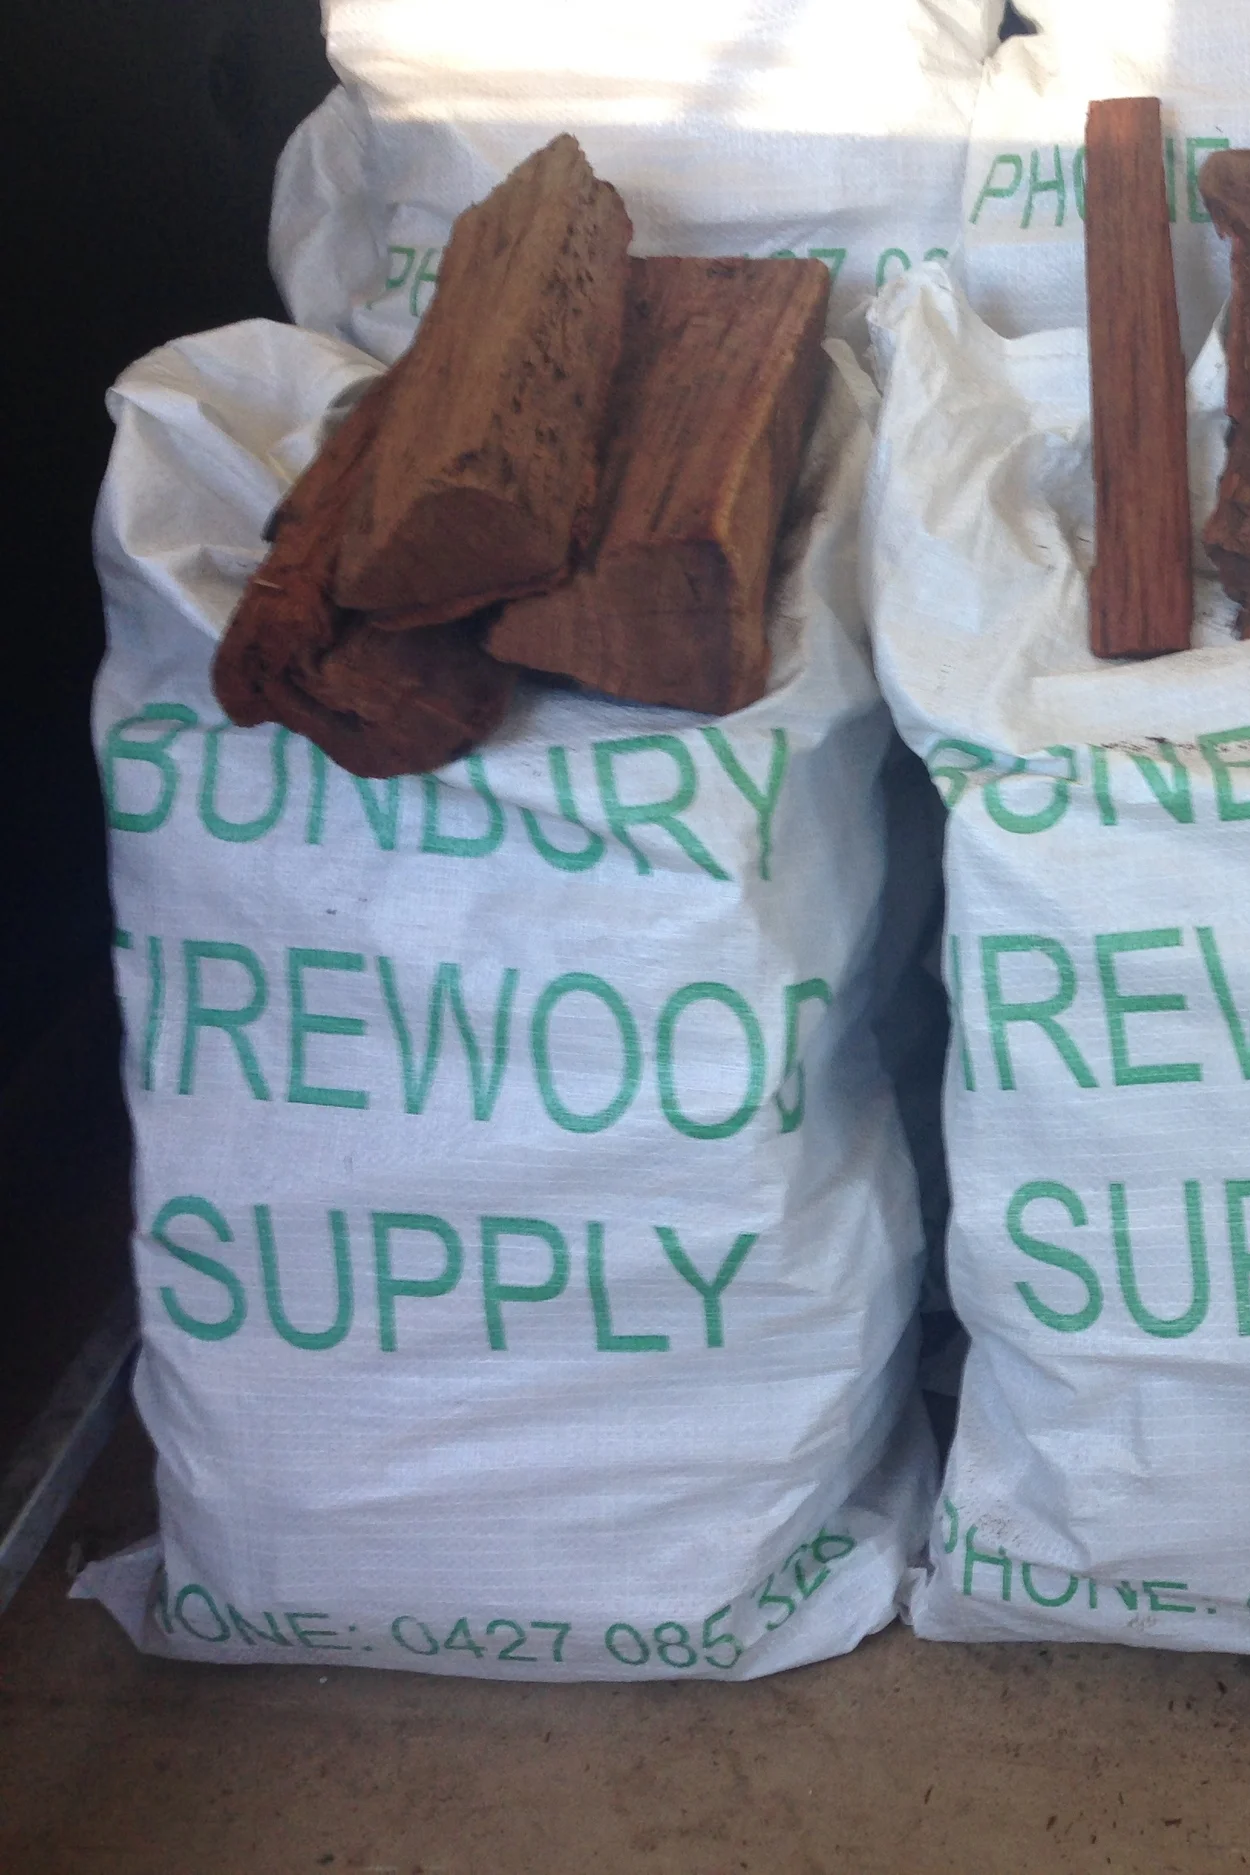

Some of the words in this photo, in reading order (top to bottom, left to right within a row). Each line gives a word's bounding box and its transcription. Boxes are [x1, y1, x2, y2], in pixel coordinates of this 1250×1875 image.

[150, 1194, 760, 1353] SUPPLY
[391, 1615, 569, 1663] 0427
[604, 1604, 744, 1669] 085
